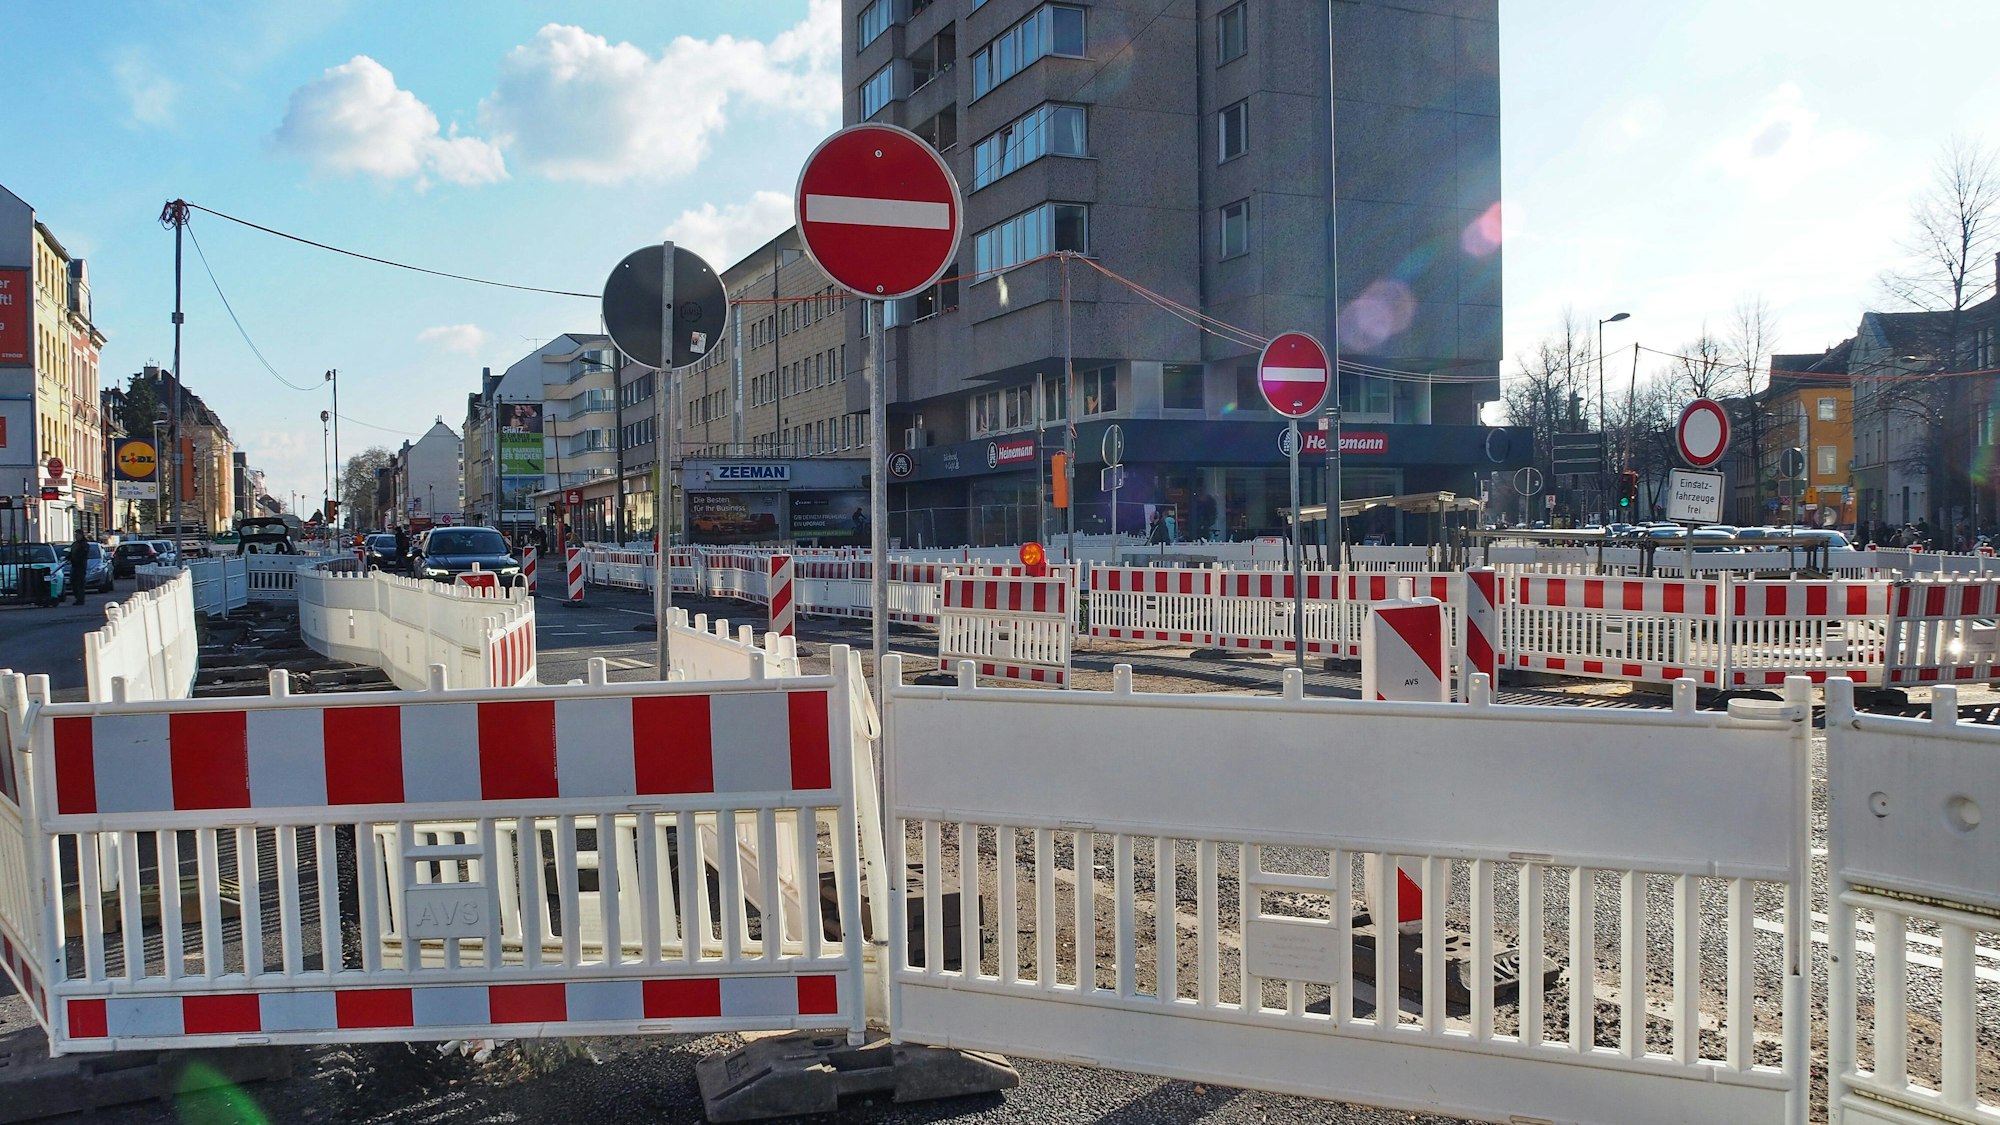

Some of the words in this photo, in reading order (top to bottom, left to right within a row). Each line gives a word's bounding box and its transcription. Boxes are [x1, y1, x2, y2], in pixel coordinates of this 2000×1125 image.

[1306, 435, 1383, 449] Heemann
[998, 445, 1033, 460] Heinemann
[720, 466, 785, 478] ZEEMAN
[1680, 479, 1712, 489] Einsatz-
[1675, 491, 1715, 504] fahrzeuge
[1688, 505, 1701, 514] frei
[1404, 678, 1419, 686] AVS
[416, 900, 480, 927] AVS
